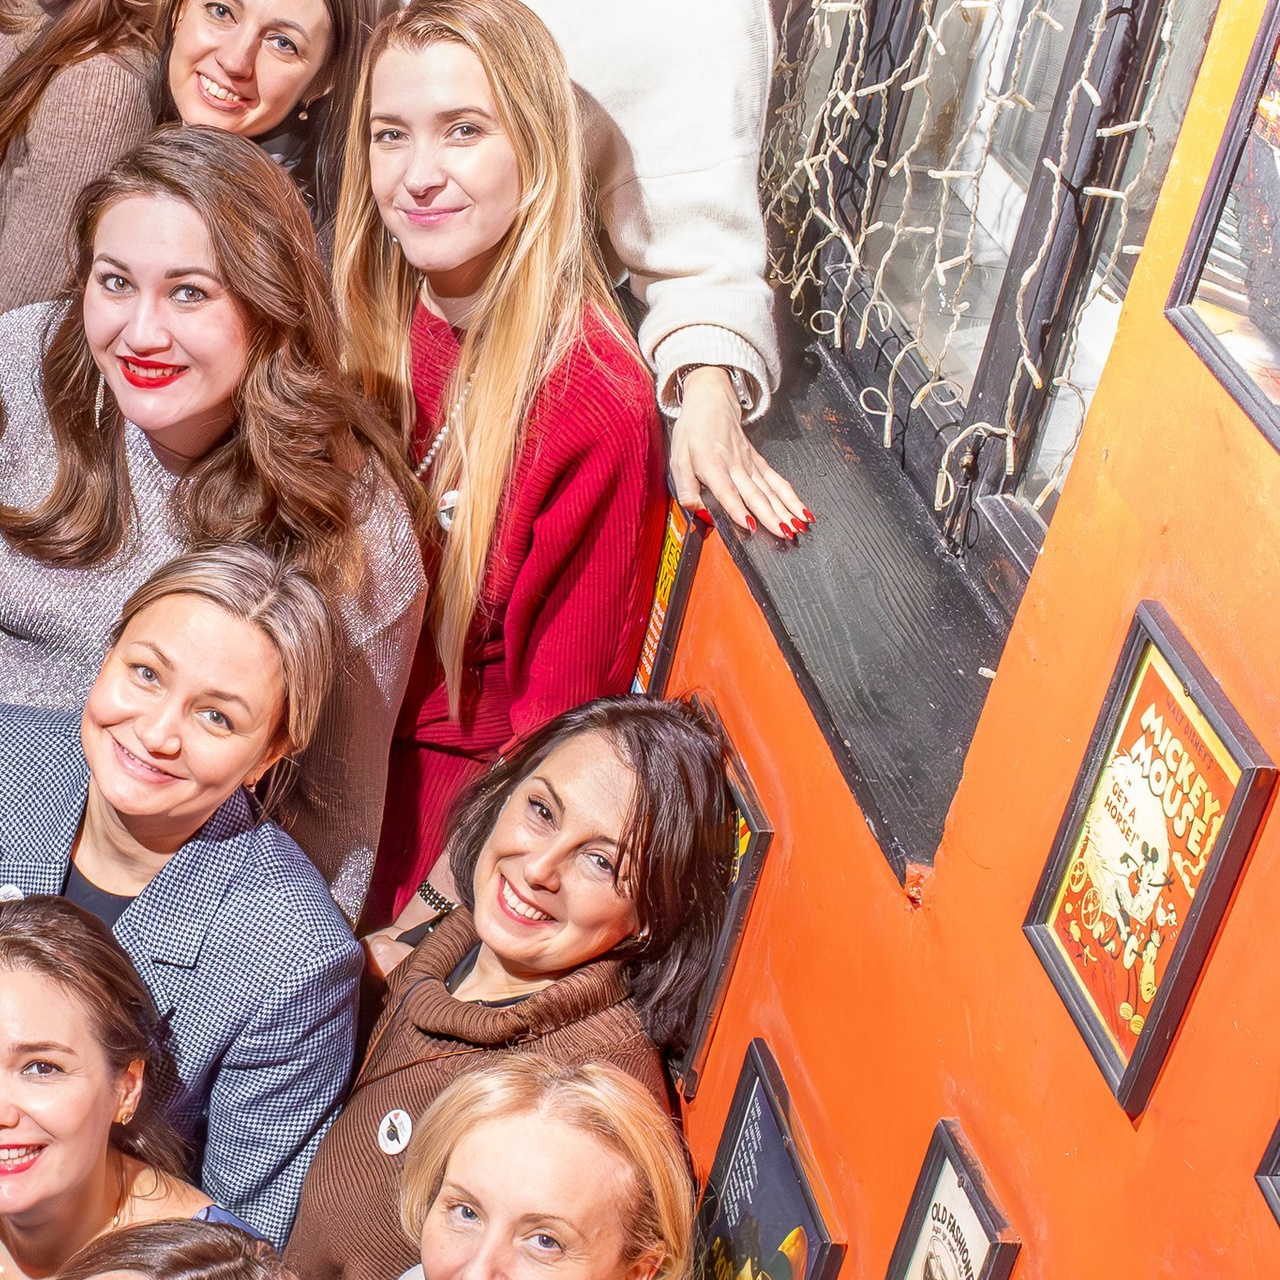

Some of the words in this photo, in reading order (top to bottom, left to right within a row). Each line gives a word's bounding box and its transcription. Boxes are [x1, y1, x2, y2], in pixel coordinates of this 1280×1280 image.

[1140, 702, 1220, 819] MICKEY
[1128, 807, 1136, 823] A
[1130, 735, 1209, 857] MOUSE
[931, 1202, 947, 1226] OLD
